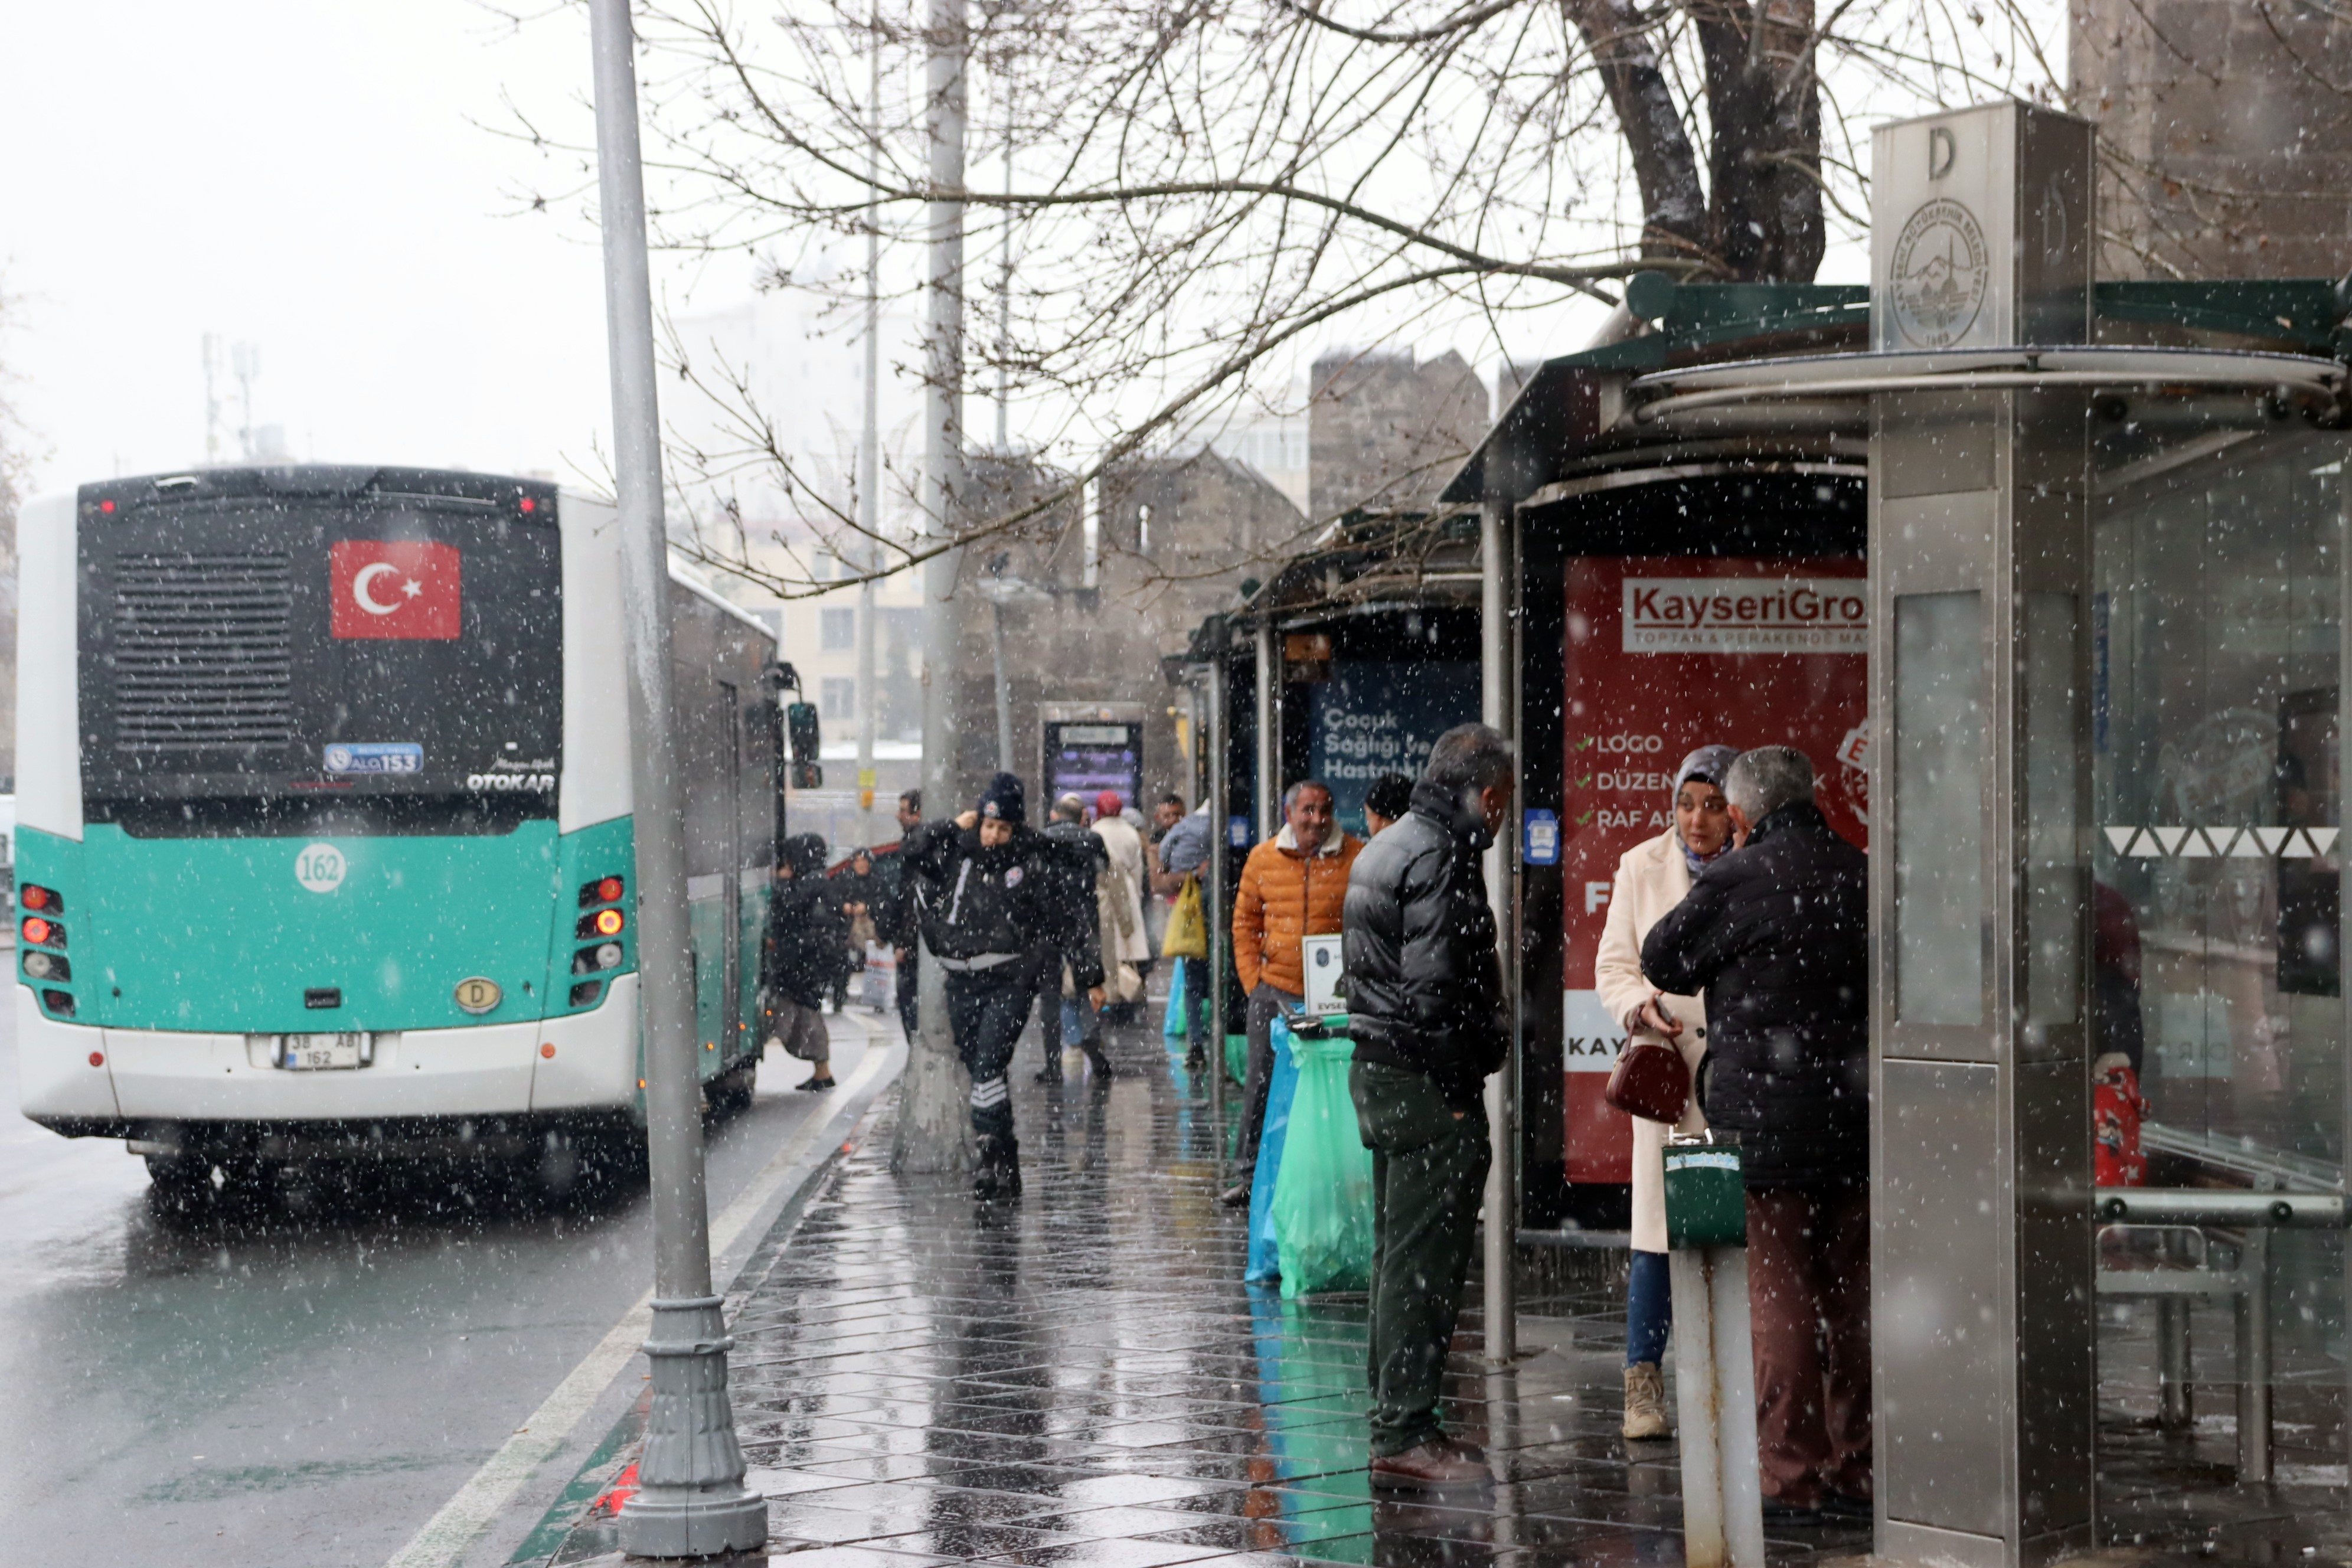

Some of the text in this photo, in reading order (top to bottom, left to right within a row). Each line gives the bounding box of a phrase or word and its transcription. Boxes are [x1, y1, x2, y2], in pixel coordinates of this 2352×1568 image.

[1929, 127, 1956, 181] D
[1634, 587, 1867, 629] KayseriGro
[1635, 632, 1703, 644] TOPTAN
[1840, 633, 1867, 644] MA
[1325, 708, 1397, 731] Çocuk
[1324, 731, 1432, 759] Sağlığı ve
[1598, 735, 1662, 753] LOGO
[380, 755, 416, 772] 153
[466, 774, 555, 791] OTOKAR
[1598, 811, 1642, 827] RAF
[302, 854, 339, 881] 162
[471, 985, 484, 1004] D
[293, 1035, 311, 1049] 38
[1569, 1037, 1627, 1055] KAY
[307, 1051, 331, 1064] 162
